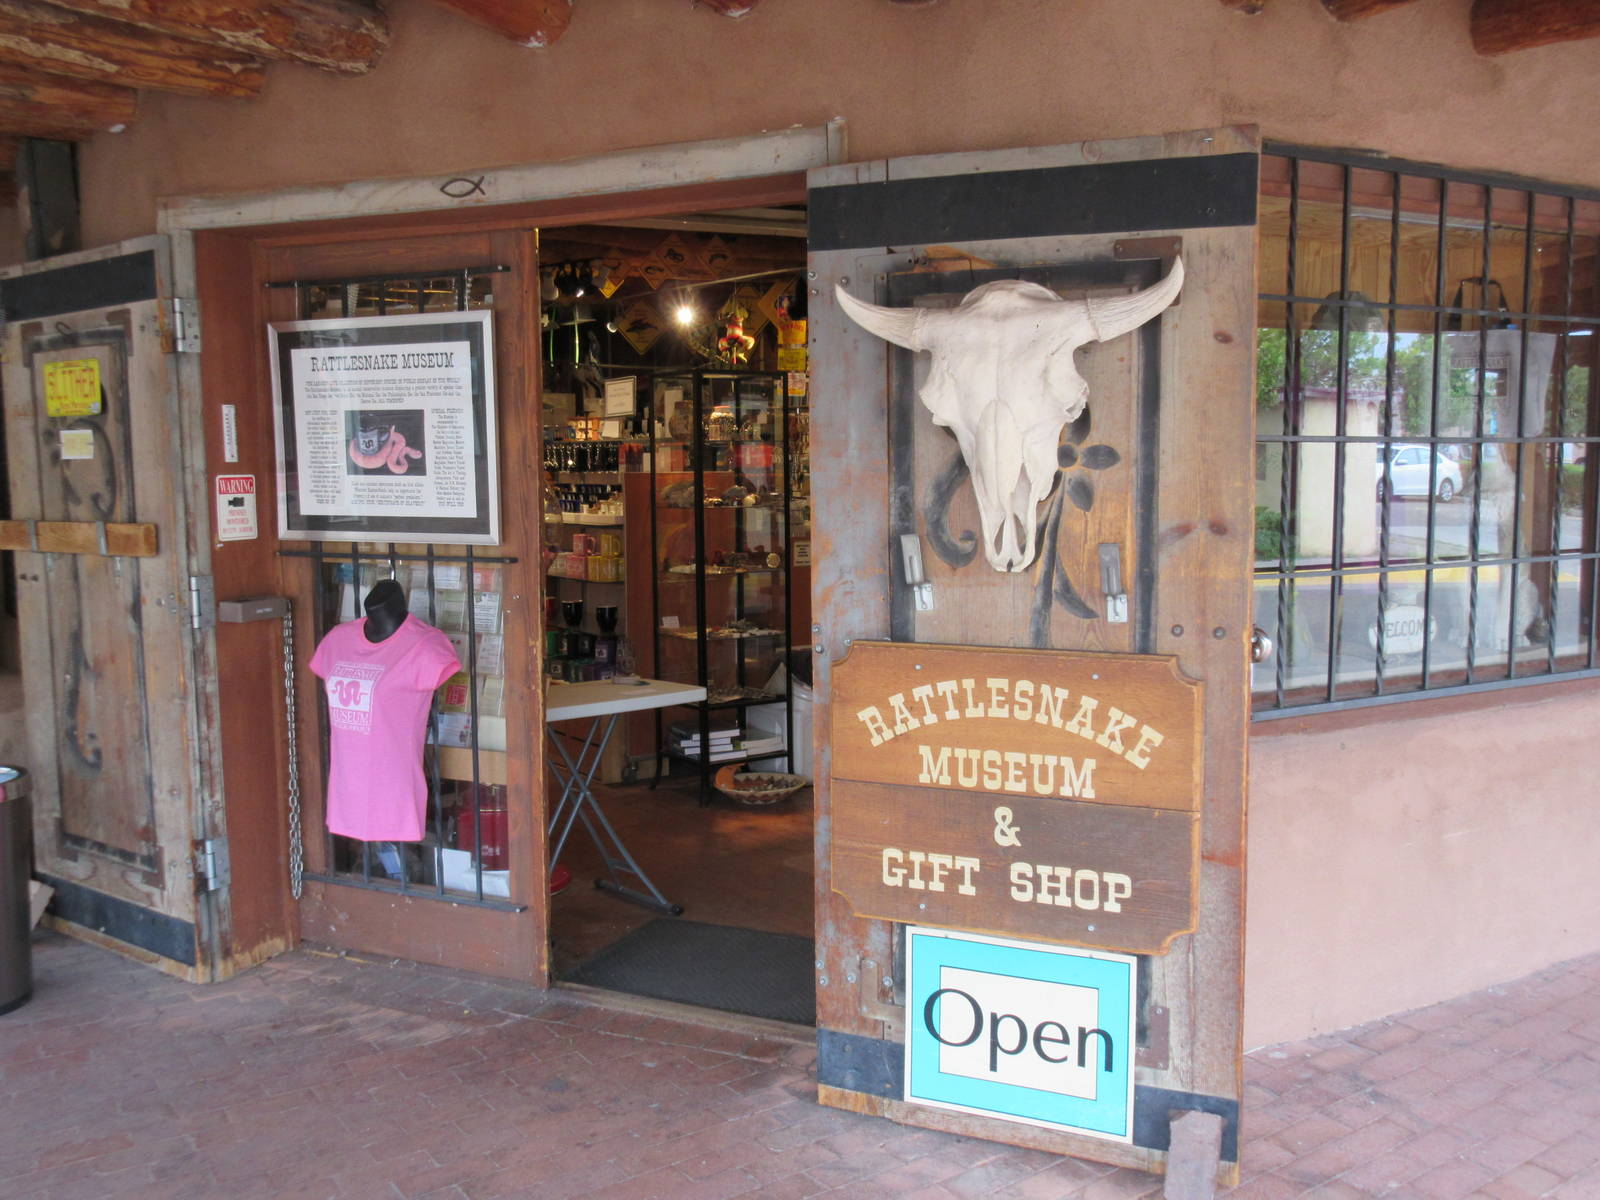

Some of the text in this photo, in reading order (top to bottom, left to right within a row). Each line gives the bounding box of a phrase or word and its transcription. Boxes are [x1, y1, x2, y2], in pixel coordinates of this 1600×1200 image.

[310, 352, 454, 372] RATTLESNAKE MUSEUM
[219, 479, 255, 494] WARNING
[331, 707, 370, 726] MUSEUM
[856, 677, 1165, 770] RATTLESNAKE
[918, 745, 1097, 799] MUSEUM
[993, 806, 1022, 847] &
[882, 848, 1132, 913] GIFT SHOP
[923, 987, 1114, 1073] Open
